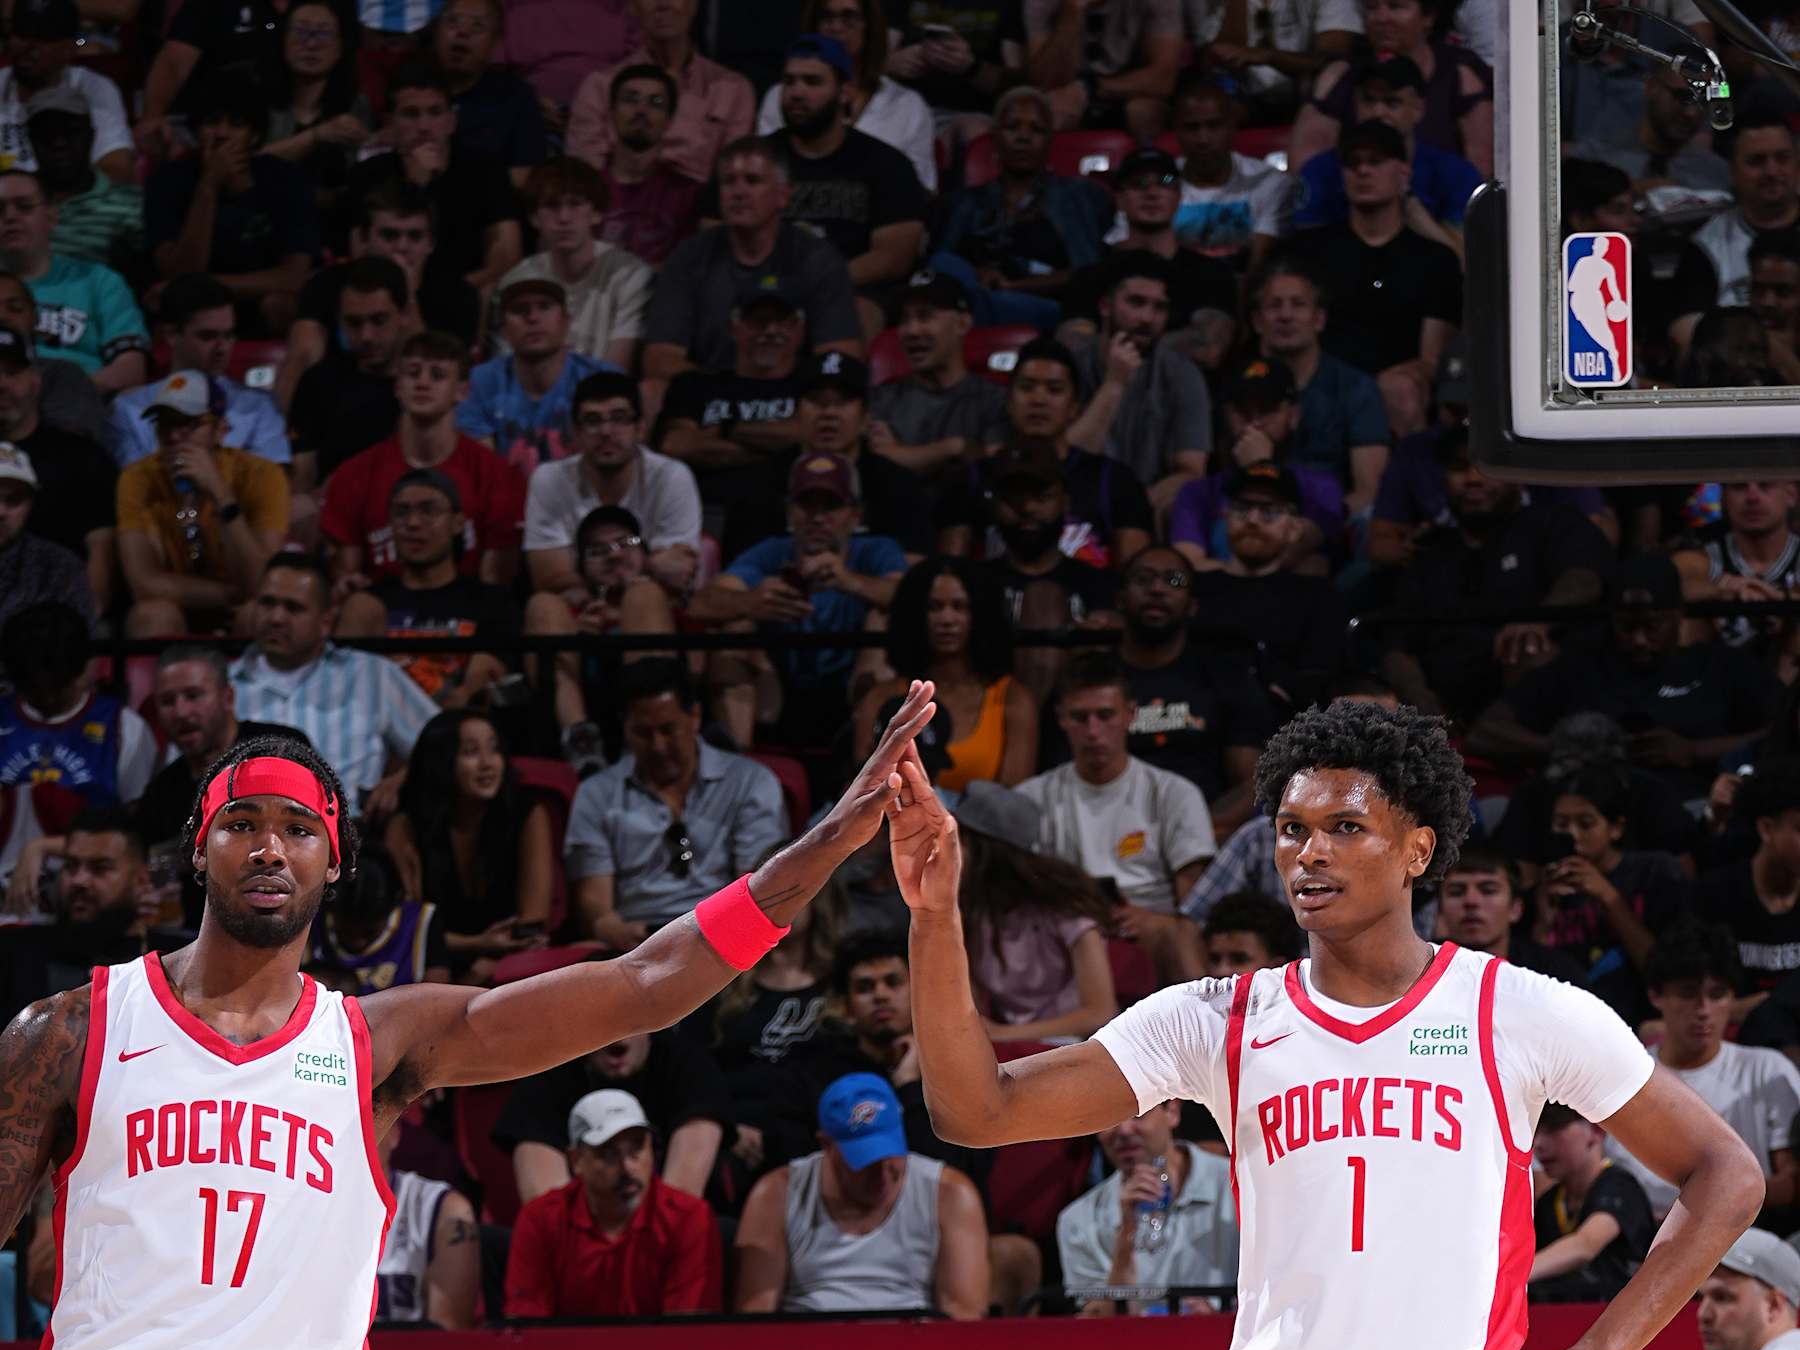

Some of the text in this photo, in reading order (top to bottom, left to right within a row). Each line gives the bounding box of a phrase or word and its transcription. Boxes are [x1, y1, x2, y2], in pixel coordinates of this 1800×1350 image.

[1574, 352, 1606, 376] NBA
[1412, 1025, 1469, 1040] credit
[1409, 1040, 1469, 1056] karma
[296, 1051, 347, 1070] credit
[294, 1064, 347, 1087] karma
[1257, 1077, 1463, 1167] ROCKETS
[126, 1100, 334, 1194] ROCKETS
[1347, 1156, 1367, 1252] 1
[199, 1187, 266, 1289] 17
